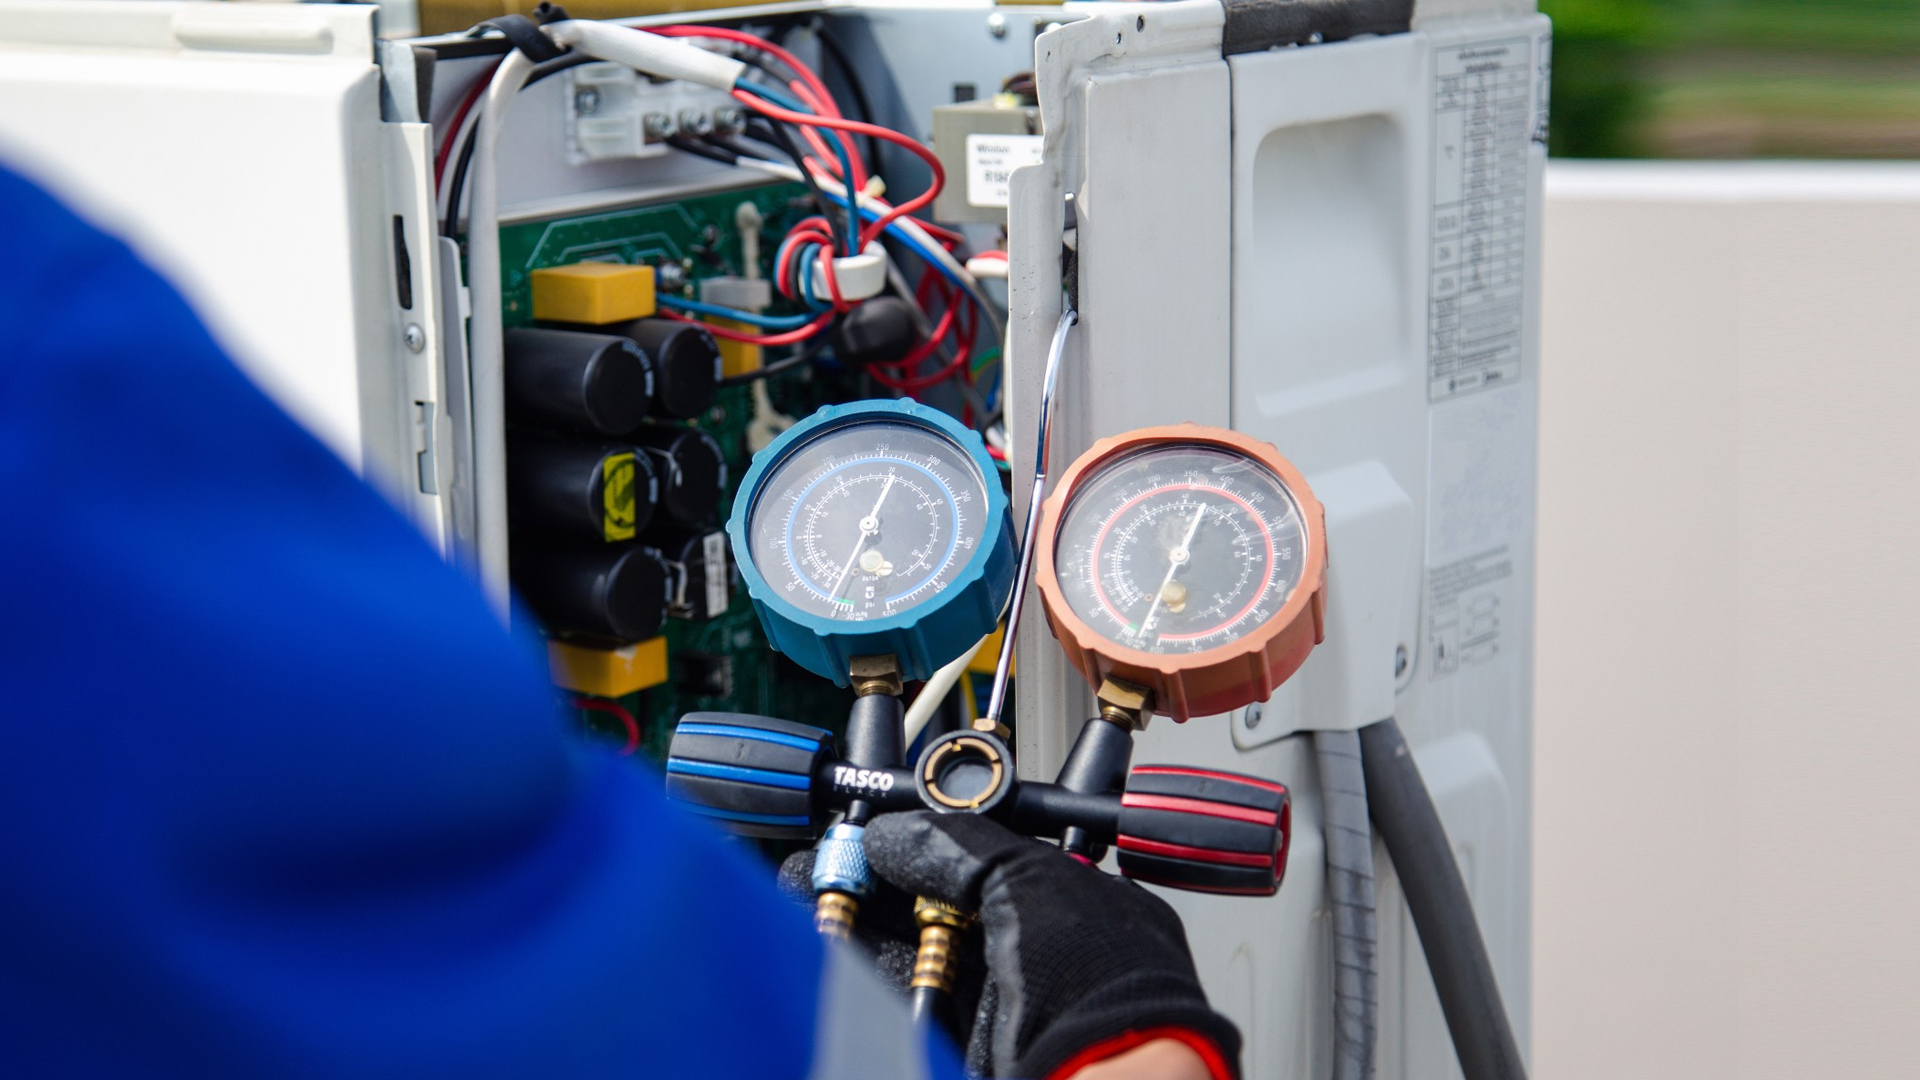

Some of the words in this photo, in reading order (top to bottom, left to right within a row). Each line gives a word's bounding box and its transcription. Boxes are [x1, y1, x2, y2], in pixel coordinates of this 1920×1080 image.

[876, 443, 890, 451] 250
[821, 454, 835, 466] 200
[926, 454, 941, 465] 300
[1146, 474, 1161, 484] 300
[1219, 475, 1235, 485] 400
[781, 489, 794, 501] 150
[842, 490, 850, 498] 20
[960, 489, 972, 502] 350
[1113, 489, 1128, 501] 250
[1250, 491, 1265, 503] 450
[804, 503, 812, 511] 10
[1089, 513, 1102, 526] 200
[963, 536, 974, 549] 400
[1282, 547, 1292, 561] 550
[785, 582, 796, 592] 50
[933, 581, 948, 594] 450
[830, 609, 837, 617] 0
[882, 608, 897, 617] 500
[1088, 607, 1100, 618] 50
[1254, 609, 1269, 623] 650
[1224, 632, 1240, 644] 700
[1187, 645, 1203, 654] 750
[834, 766, 894, 791] TASCO
[833, 784, 888, 798] BLACK
